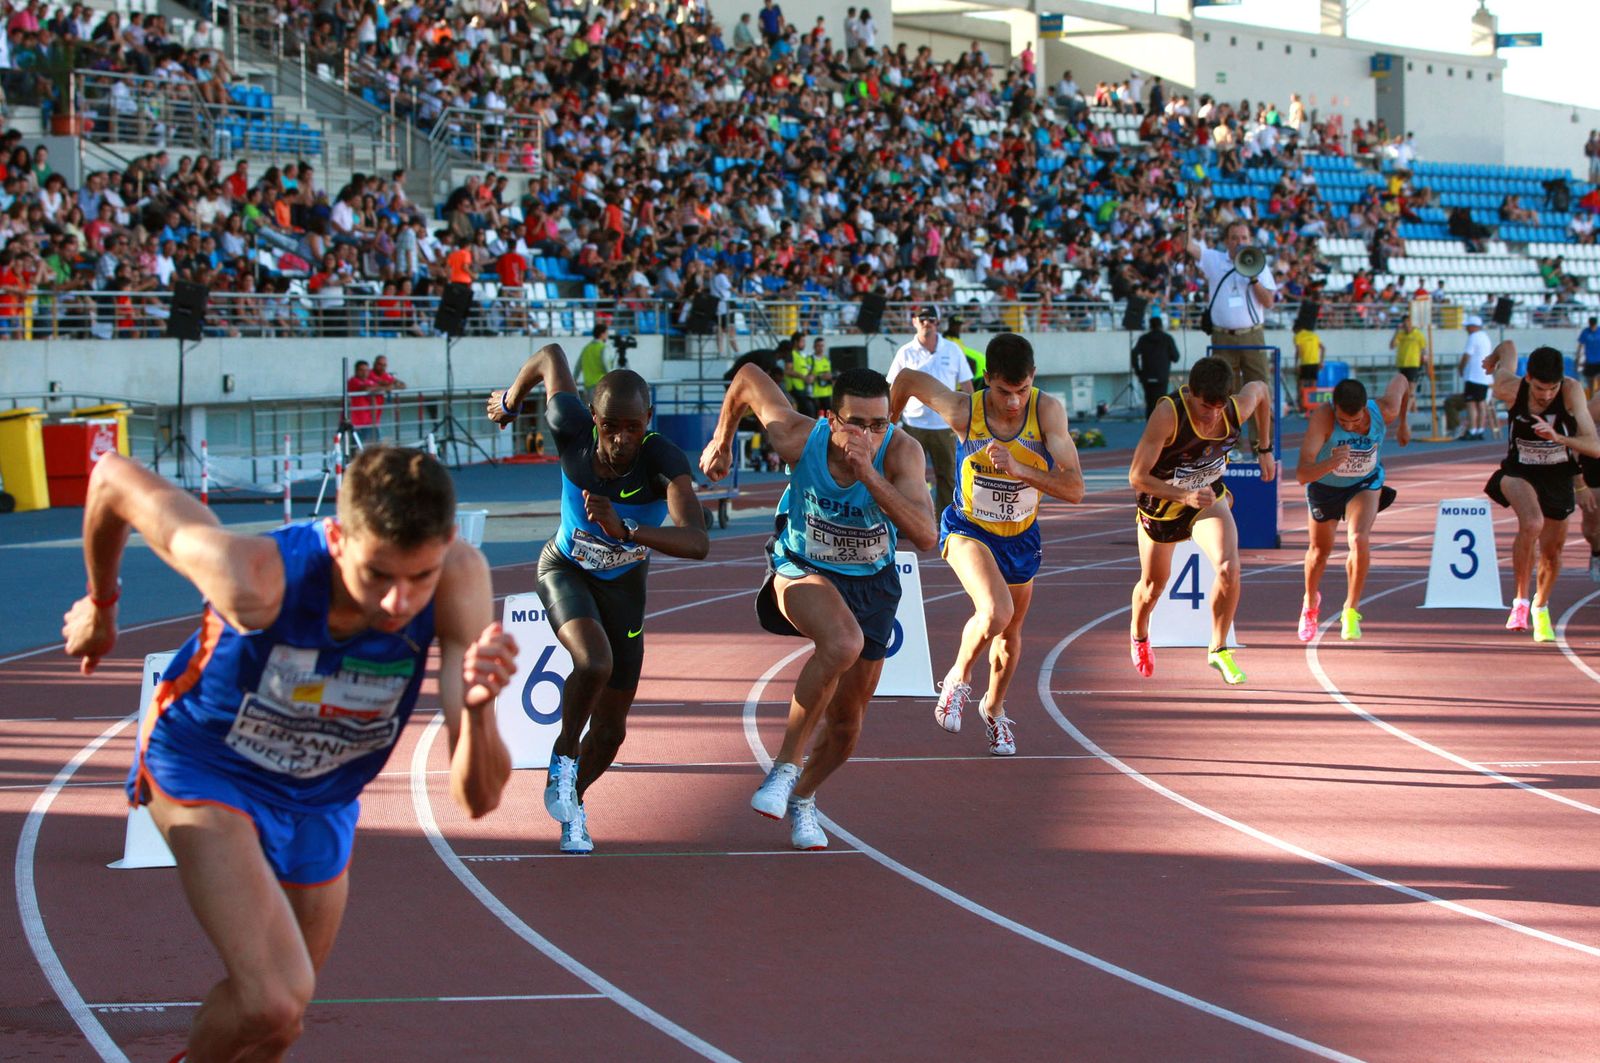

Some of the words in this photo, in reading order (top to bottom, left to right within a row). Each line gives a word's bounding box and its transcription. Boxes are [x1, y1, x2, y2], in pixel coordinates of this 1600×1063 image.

[804, 490, 864, 517] nerja
[992, 491, 1019, 503] DIEZ
[999, 504, 1014, 515] 18
[813, 529, 831, 546] EL
[833, 536, 881, 548] MEHDI
[860, 528, 886, 537] HUELVA
[838, 547, 858, 557] 23
[1450, 528, 1479, 580] 3
[1169, 553, 1204, 609] 4
[521, 645, 565, 725] 6
